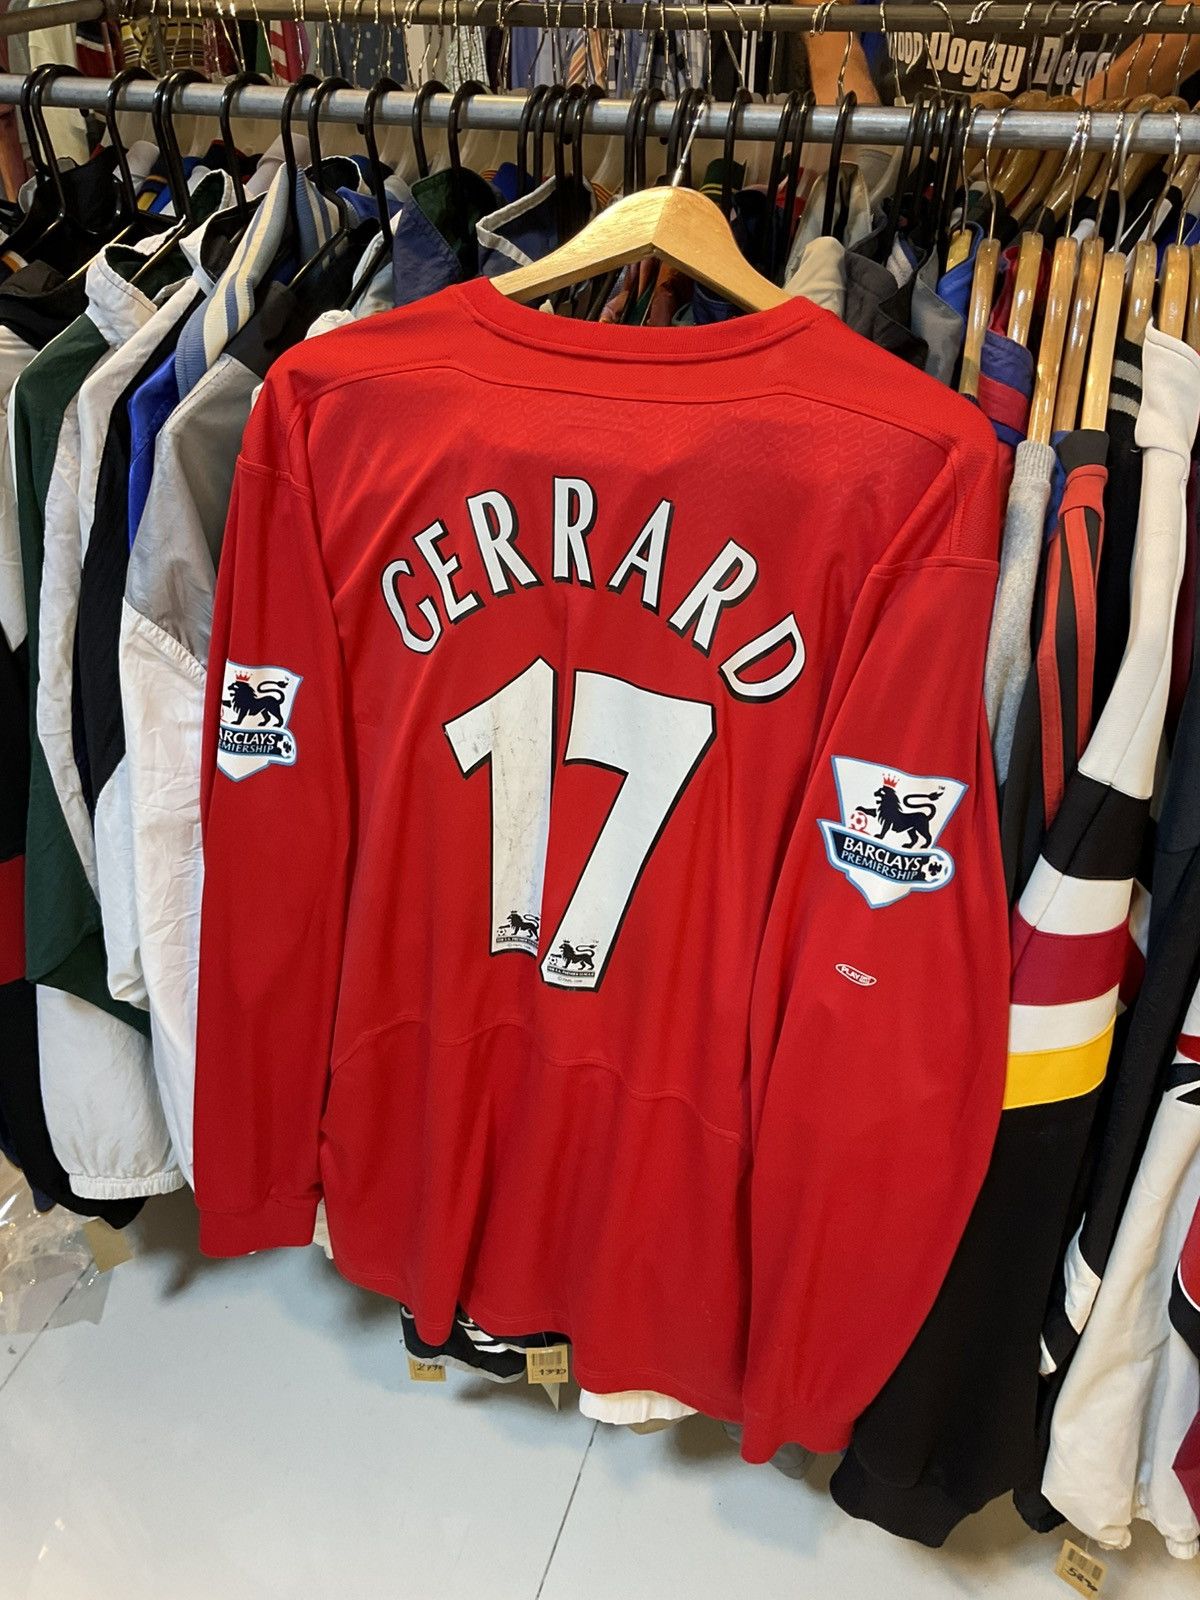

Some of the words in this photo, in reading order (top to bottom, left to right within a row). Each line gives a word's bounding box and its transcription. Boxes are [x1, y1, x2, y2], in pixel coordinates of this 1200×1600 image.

[926, 32, 1026, 92] Doggy
[381, 476, 806, 702] GERRARD
[218, 739, 275, 753] MIERSHIP
[219, 727, 277, 745] RCLAYS
[443, 657, 716, 992] 17
[841, 850, 918, 880] PREMIERSHIP
[843, 836, 922, 871] BARCLAYS
